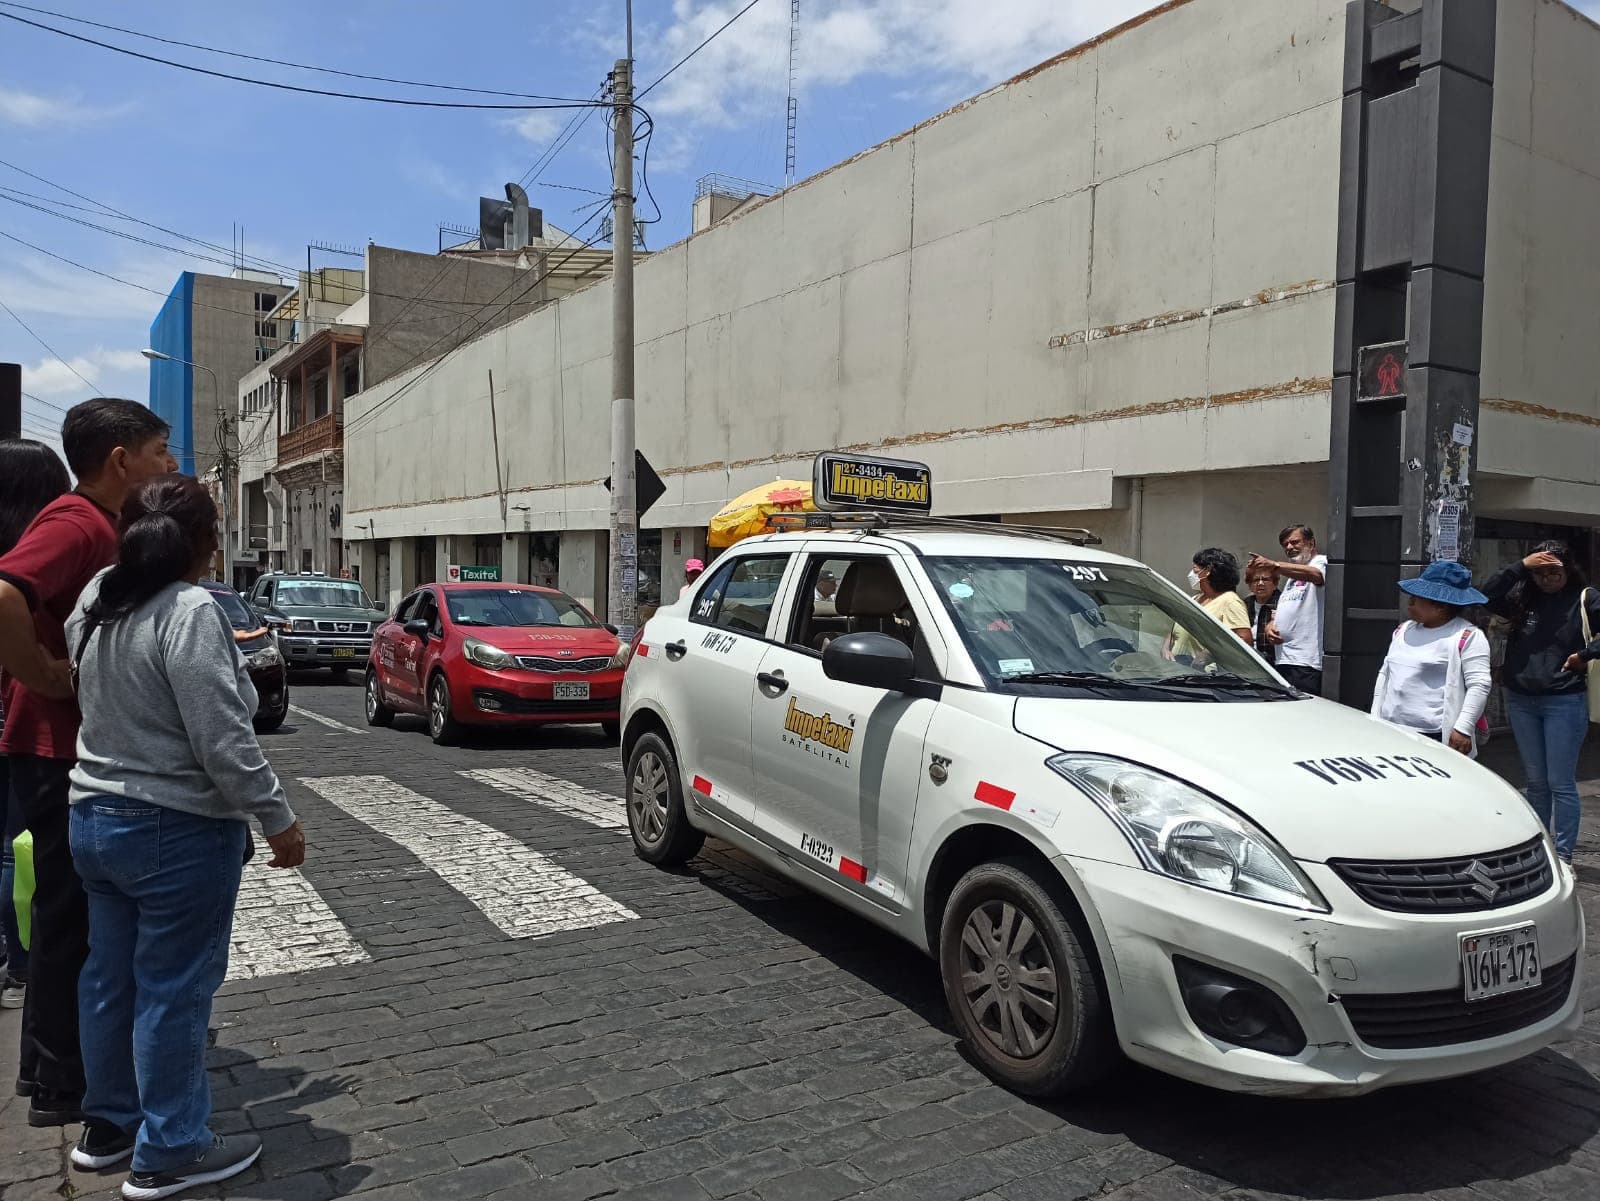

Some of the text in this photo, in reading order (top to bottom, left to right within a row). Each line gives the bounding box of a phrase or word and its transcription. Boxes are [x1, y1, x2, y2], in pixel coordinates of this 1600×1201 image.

[843, 462, 883, 477] 27-3434
[832, 462, 929, 503] Impetaxi
[461, 569, 498, 580] Taxitel
[1062, 564, 1110, 582] 297
[697, 598, 715, 617] 297
[555, 686, 588, 697] F5D-335
[784, 695, 854, 754] Impetaxi
[782, 734, 850, 769] SATELITAL
[1293, 755, 1452, 785] V6W-173
[1489, 934, 1515, 948] PERU
[1467, 942, 1538, 991] V6W-173
